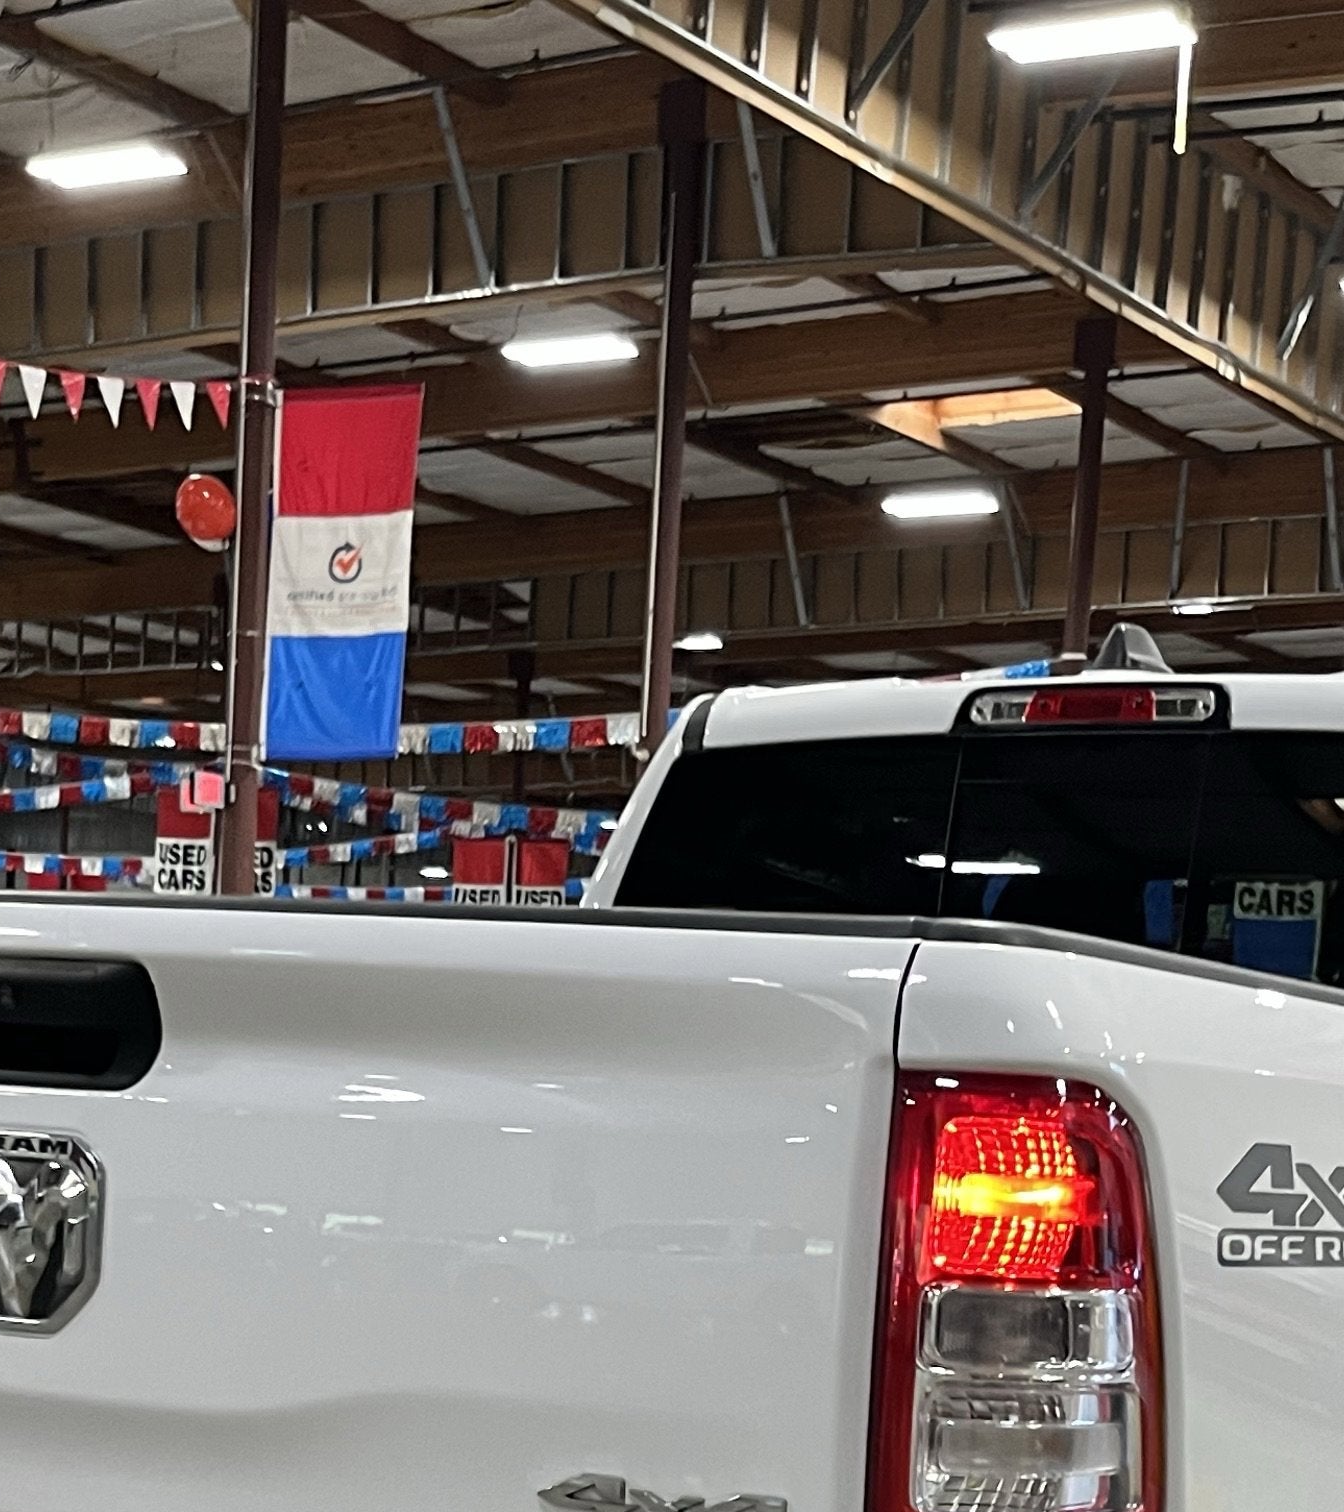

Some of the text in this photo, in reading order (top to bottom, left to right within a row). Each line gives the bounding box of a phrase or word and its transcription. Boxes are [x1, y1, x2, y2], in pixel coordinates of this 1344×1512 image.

[159, 843, 207, 866] USED
[158, 868, 206, 891] CARS
[1238, 886, 1314, 916] CARS
[1221, 1233, 1306, 1262] OFF
